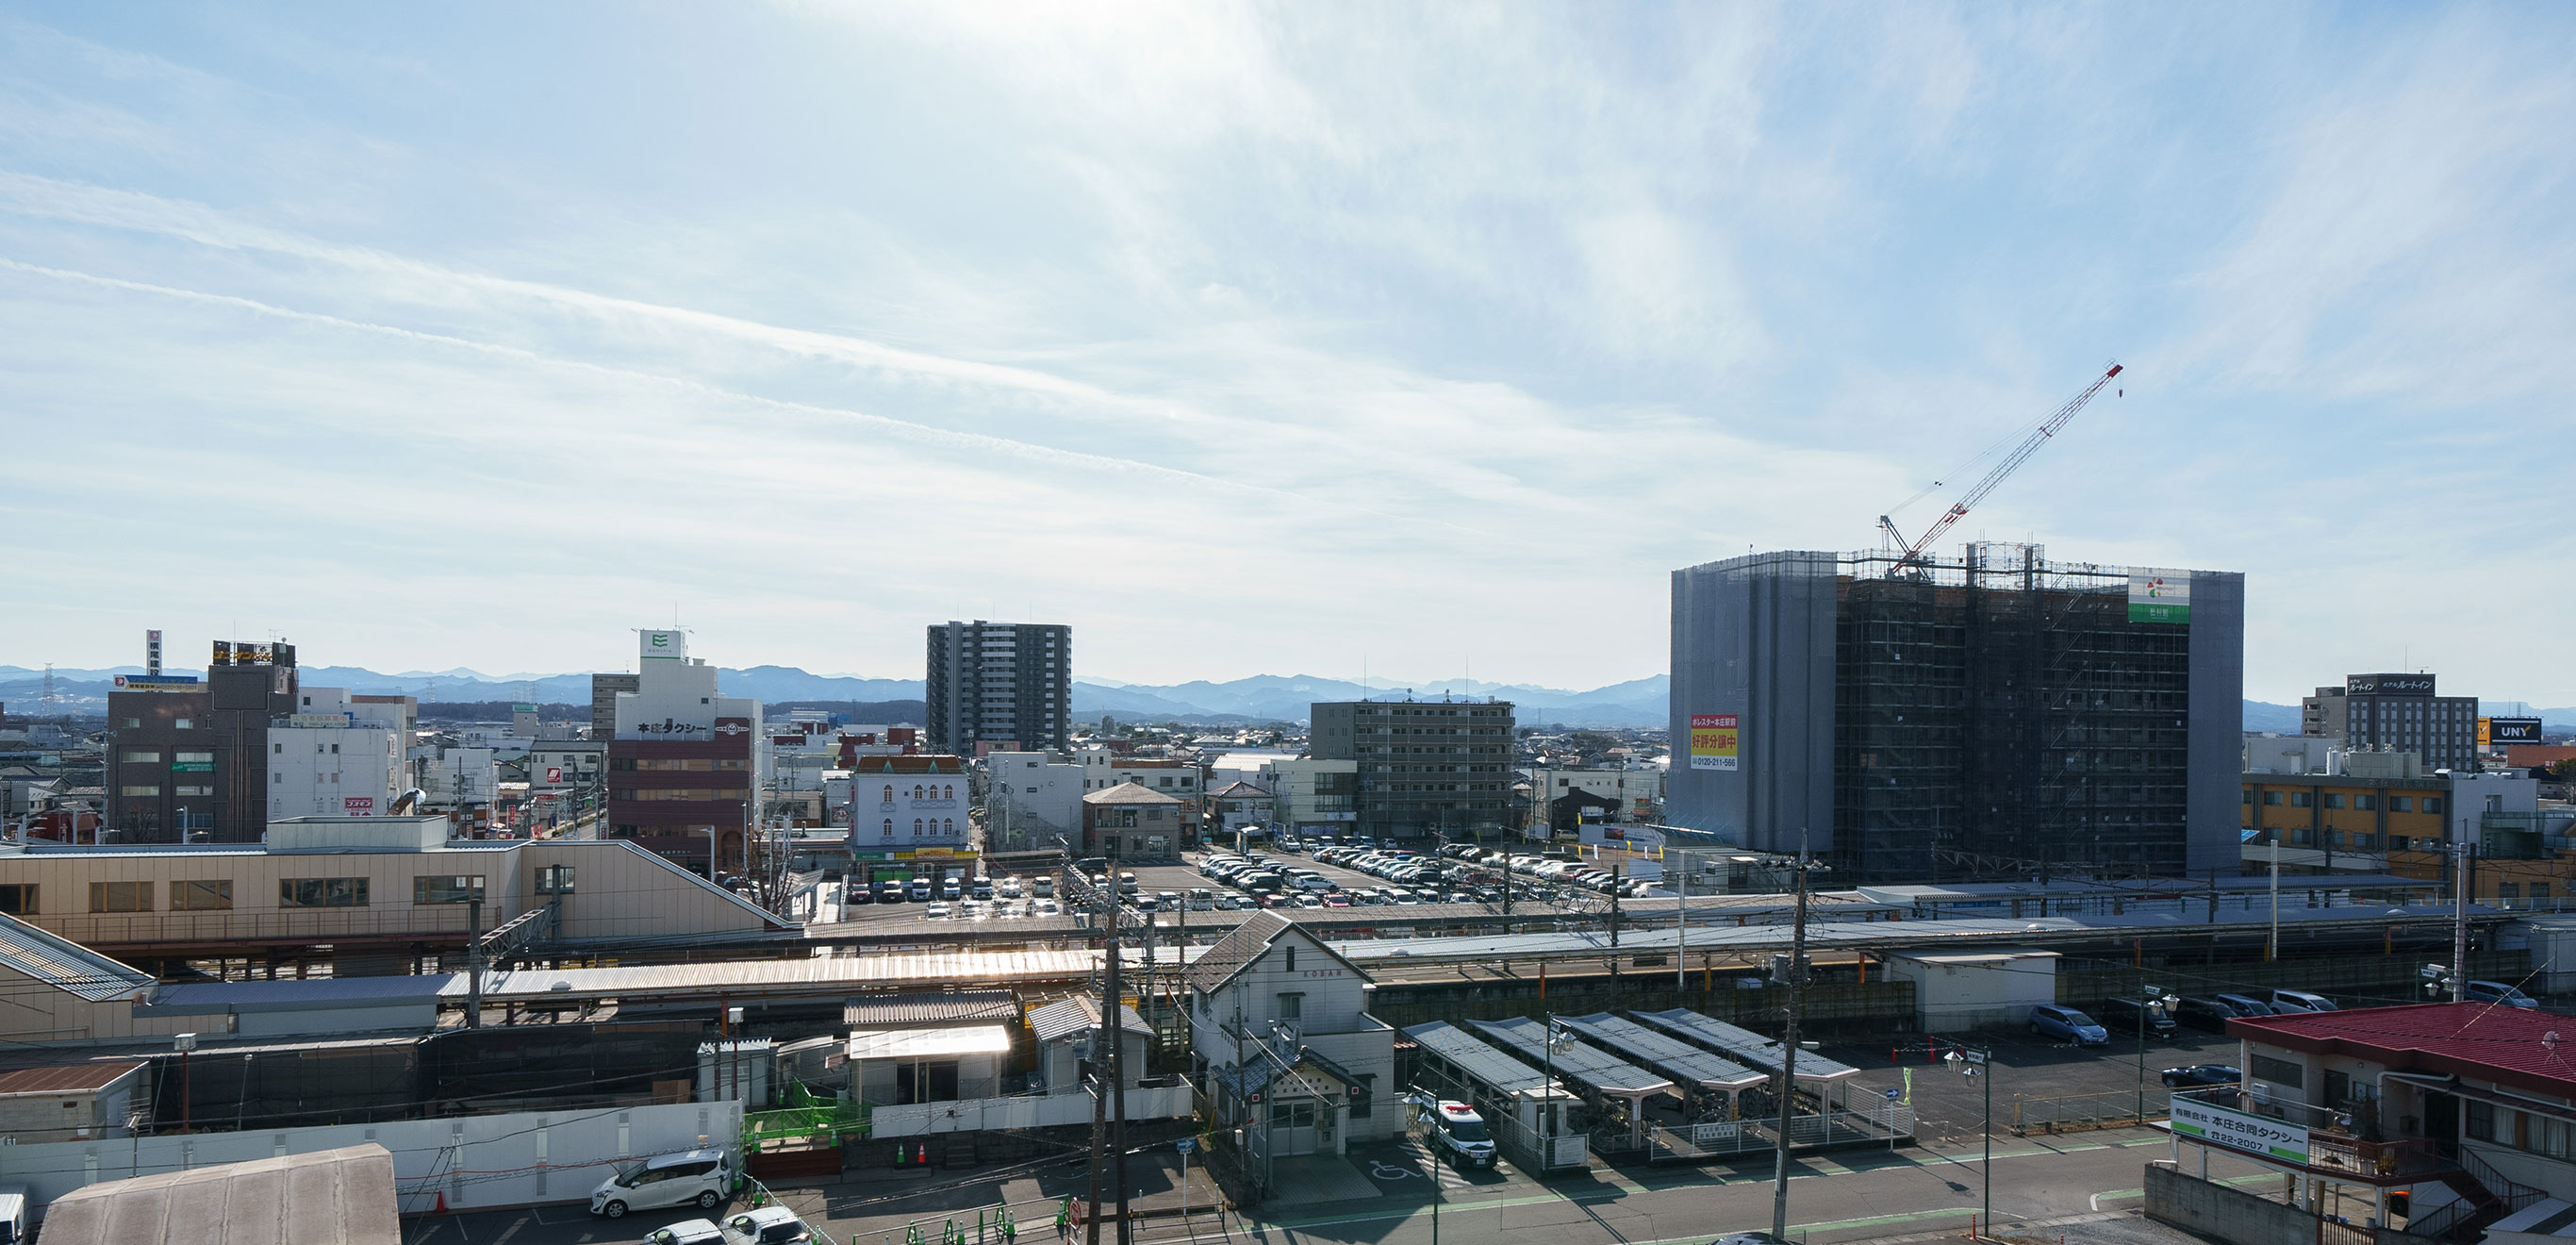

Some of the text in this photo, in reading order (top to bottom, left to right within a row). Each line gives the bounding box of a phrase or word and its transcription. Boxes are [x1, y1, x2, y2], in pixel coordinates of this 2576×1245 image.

[637, 722, 707, 734] 本庄タクシー
[2502, 724, 2532, 737] UNY
[1693, 734, 1736, 749] 好評分譲中
[1303, 969, 1342, 978] KOBAN
[2174, 1107, 2304, 1143] 有限会社 本庄合同タクシー
[2221, 1134, 2263, 1151] 22-2007
